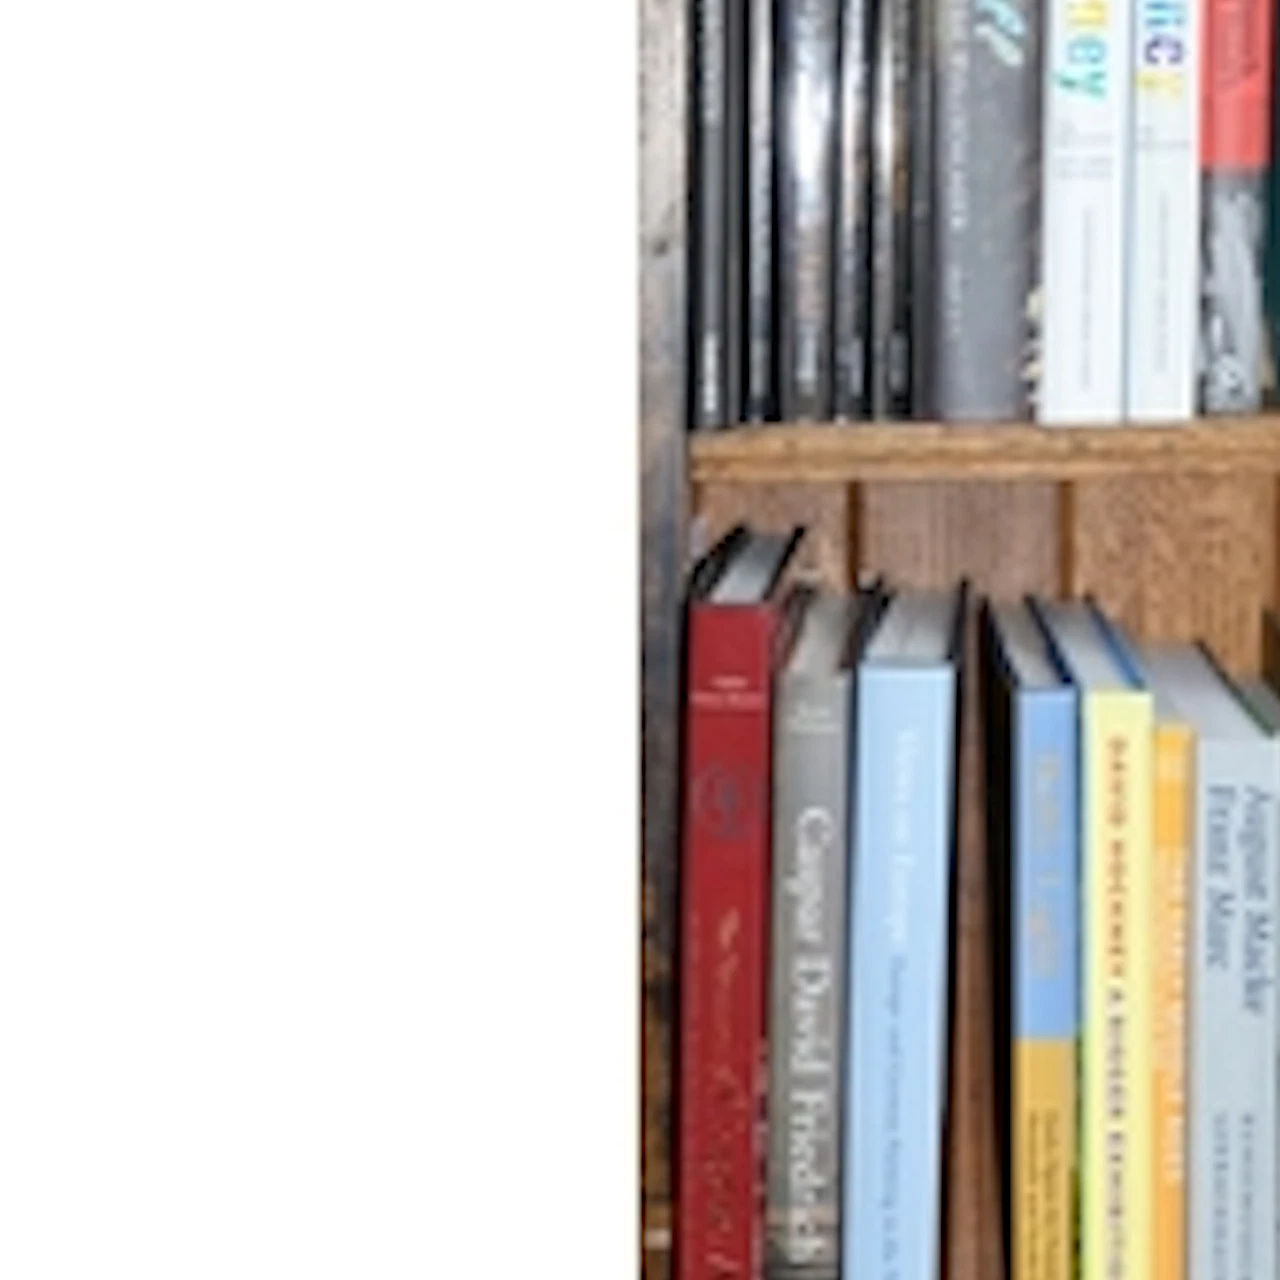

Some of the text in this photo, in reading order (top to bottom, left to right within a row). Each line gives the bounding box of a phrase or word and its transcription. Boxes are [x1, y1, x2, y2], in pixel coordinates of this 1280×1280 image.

[1105, 737, 1129, 827] DAVID
[1105, 840, 1129, 981] HOCKNEY
[1206, 784, 1237, 969] Franz Marc
[1237, 784, 1273, 1017] August Macke
[786, 807, 833, 1262] Caspar David Friedrich
[1105, 1015, 1128, 1119] BIGGER
